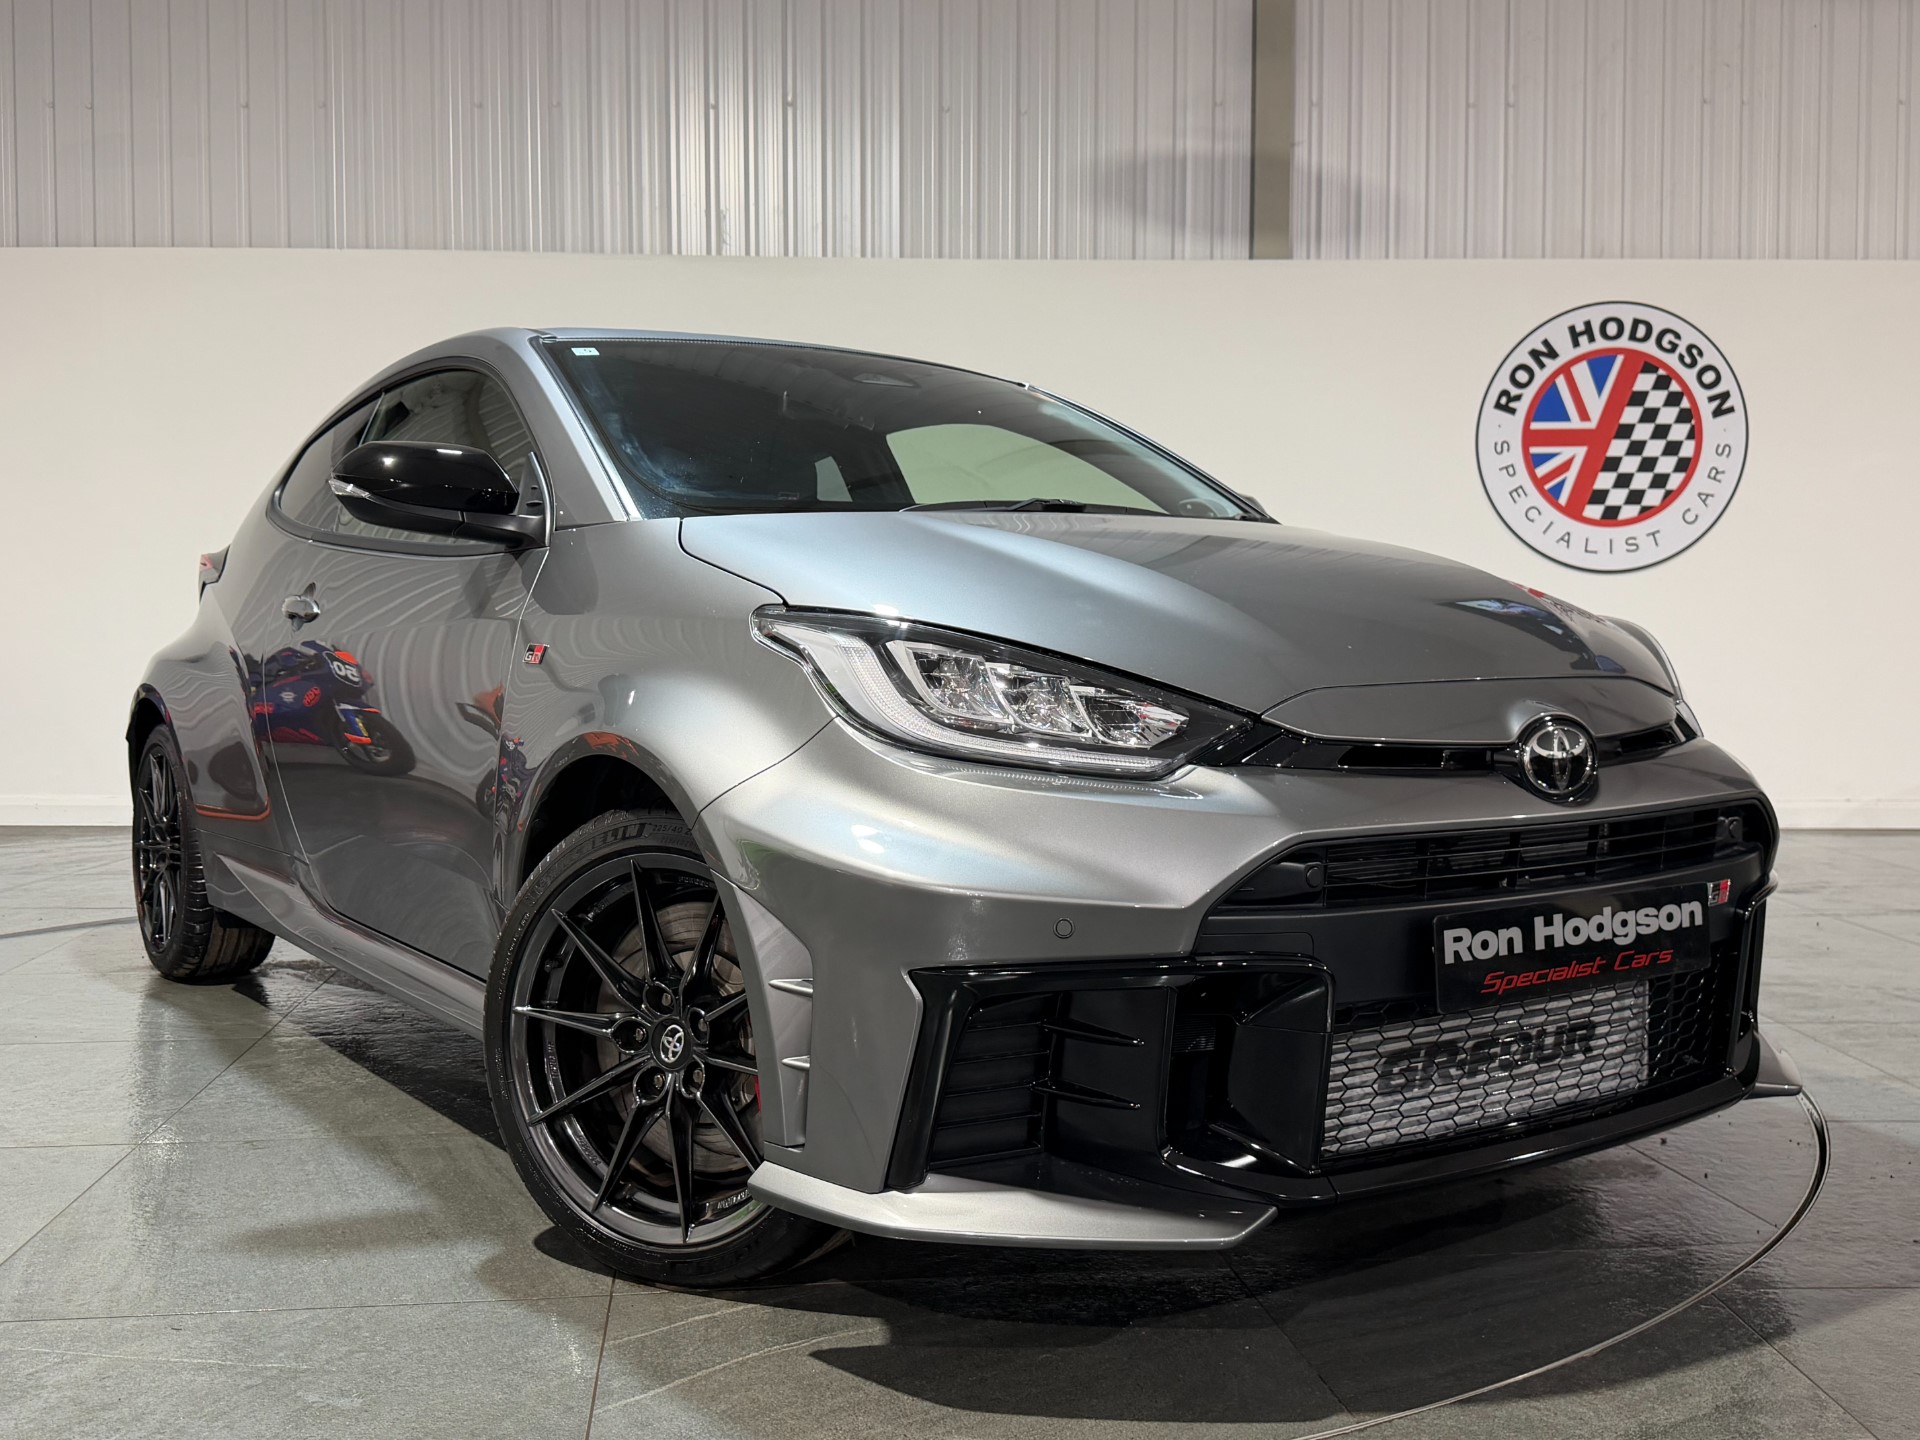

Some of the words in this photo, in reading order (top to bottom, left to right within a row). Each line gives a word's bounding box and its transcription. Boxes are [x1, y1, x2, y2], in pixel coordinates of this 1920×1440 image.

[1493, 338, 1560, 416] RON
[1567, 316, 1735, 419] HODGSON
[1494, 440, 1661, 555] SPECIALIST
[1682, 442, 1732, 525] CARS
[1443, 926, 1523, 965] Ron
[1533, 901, 1703, 950] Hodgson
[1480, 958, 1607, 995] Specialist
[1614, 949, 1674, 971] Cars
